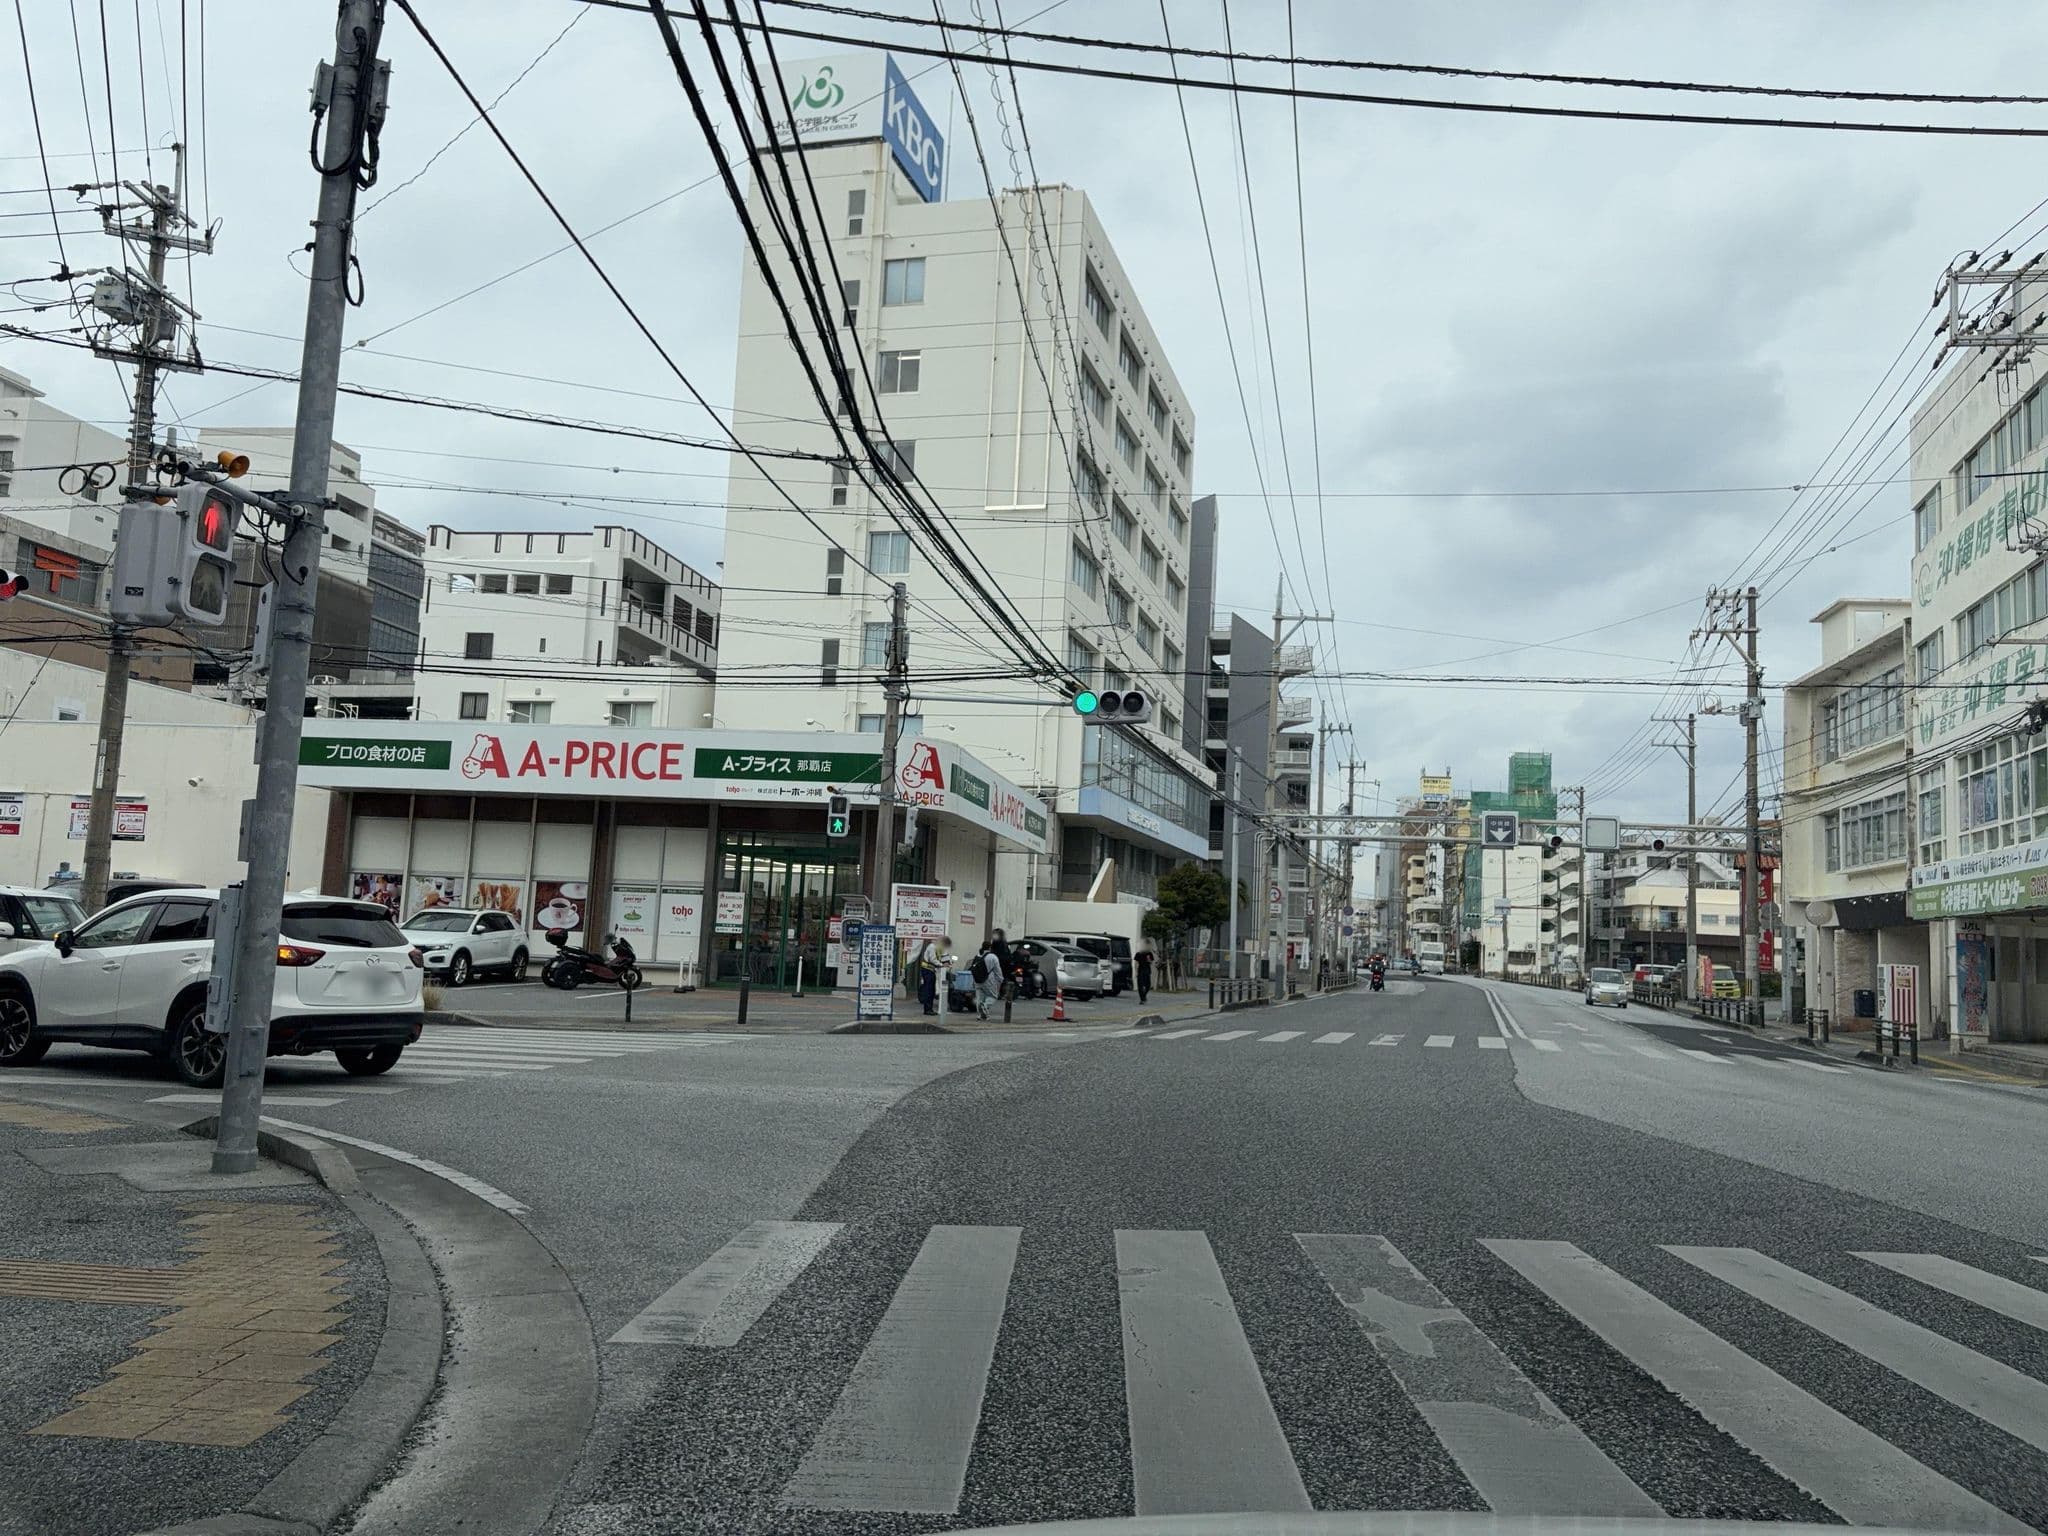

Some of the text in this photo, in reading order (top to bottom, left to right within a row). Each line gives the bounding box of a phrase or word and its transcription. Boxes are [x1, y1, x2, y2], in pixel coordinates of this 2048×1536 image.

[887, 76, 939, 187] KBC
[325, 744, 426, 763] プロの食材の店
[518, 740, 683, 780] A-PRICE
[721, 755, 832, 774] A-プライス 那覇店
[902, 790, 944, 807] A-PRICE
[672, 905, 693, 917] toho
